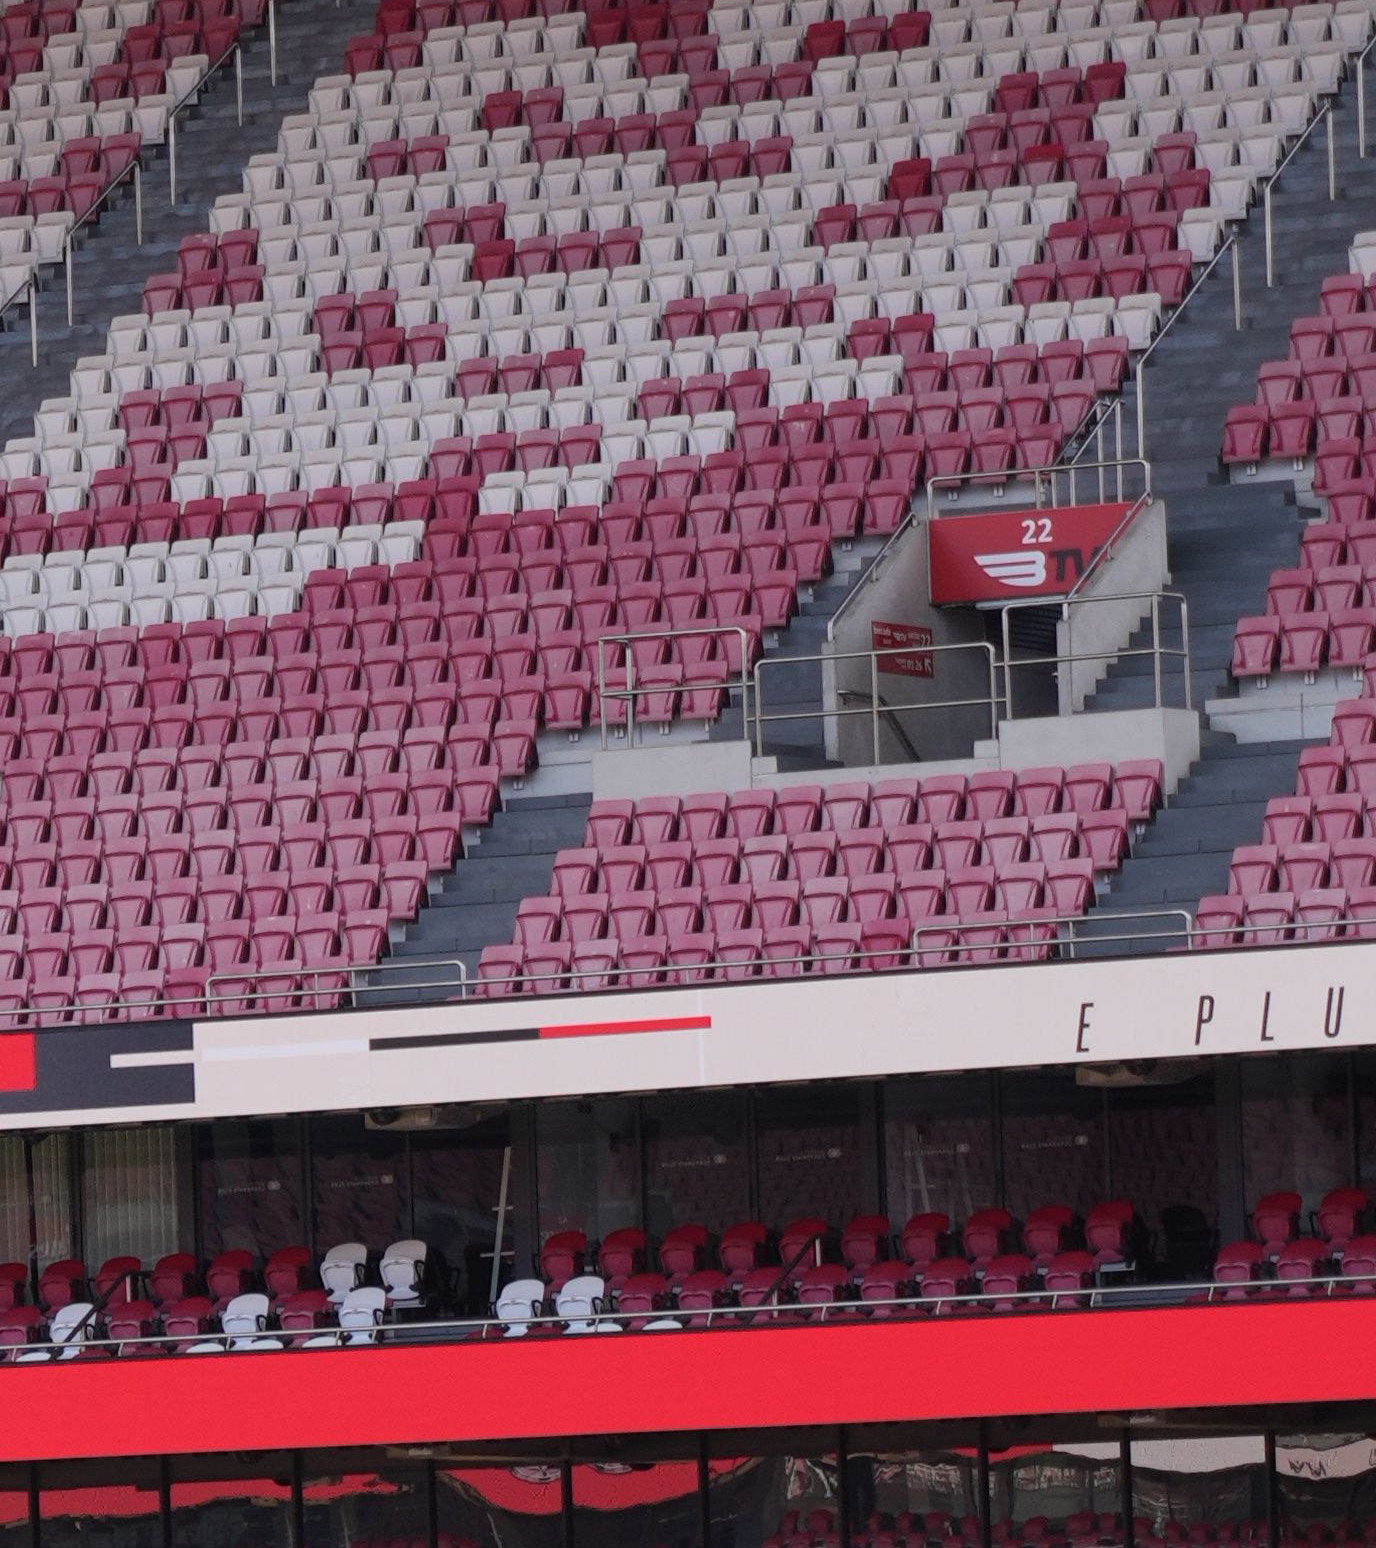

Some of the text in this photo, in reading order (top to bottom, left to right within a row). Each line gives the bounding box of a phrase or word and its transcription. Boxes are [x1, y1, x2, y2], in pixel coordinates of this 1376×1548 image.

[1020, 517, 1053, 545] 22
[1076, 985, 1345, 1053] E PLU
